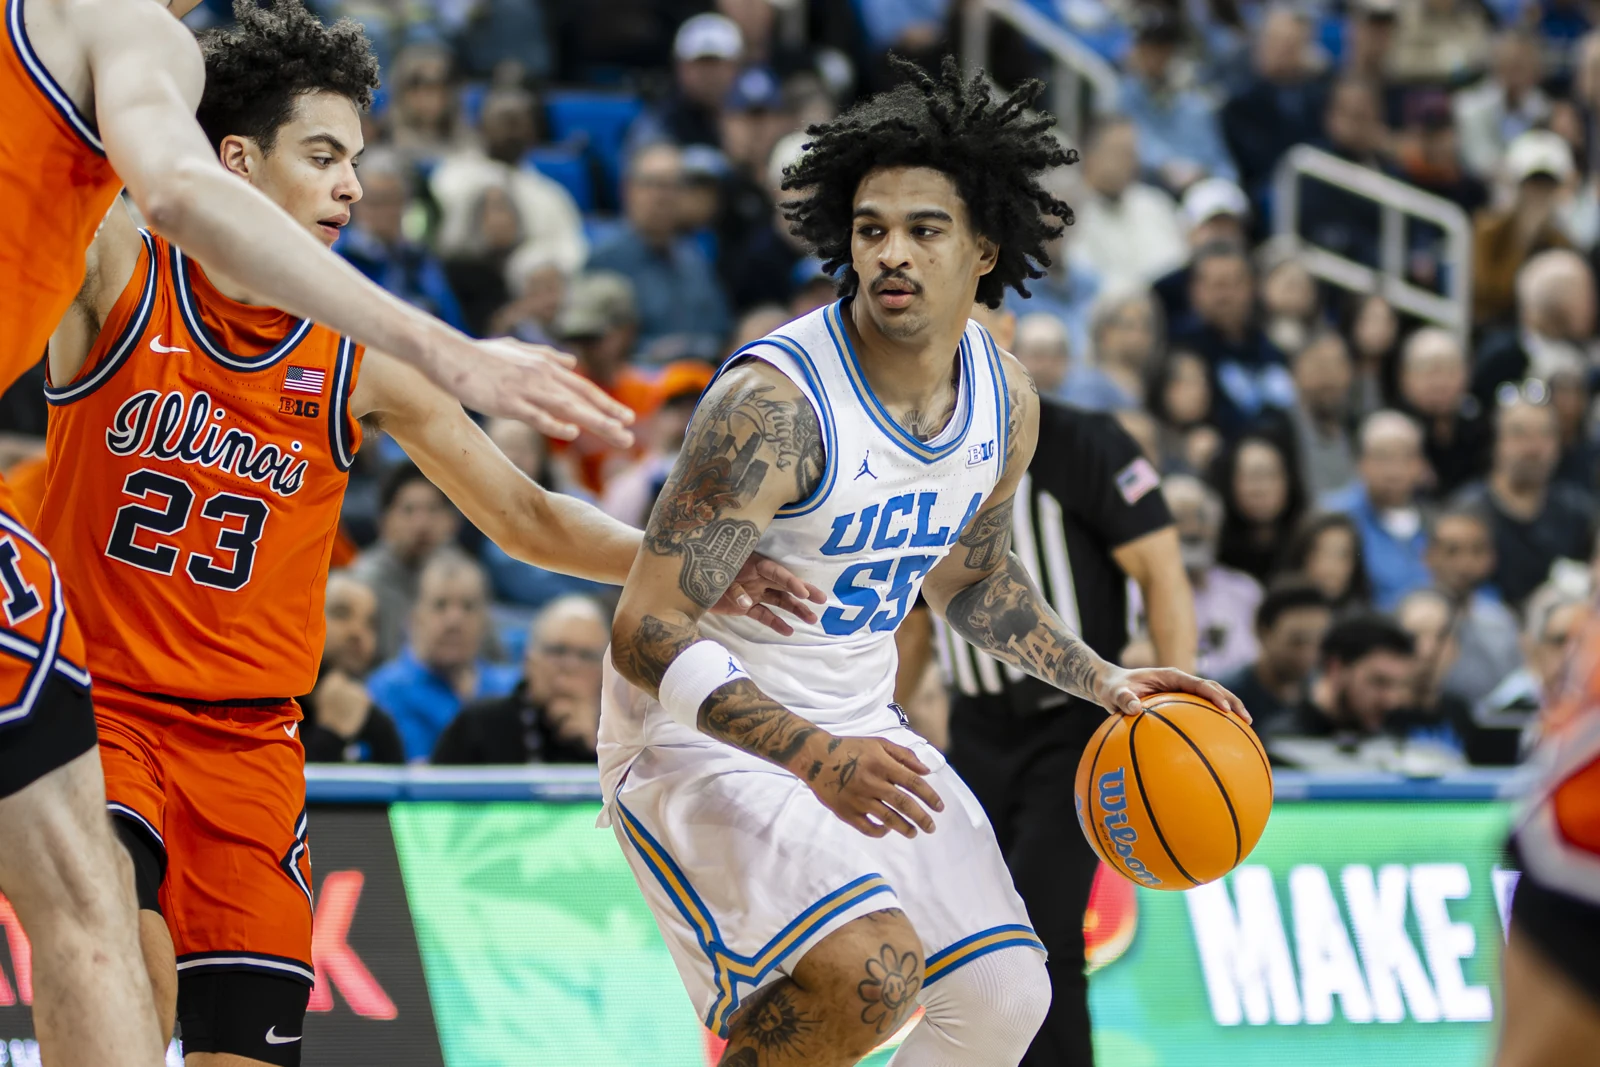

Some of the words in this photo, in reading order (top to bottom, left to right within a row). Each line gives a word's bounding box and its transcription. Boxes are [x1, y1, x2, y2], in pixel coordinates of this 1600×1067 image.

[105, 390, 308, 496] Illinois
[105, 468, 270, 591] 23
[821, 555, 940, 636] 55
[1098, 766, 1162, 885] Wilson
[1183, 863, 1494, 1026] MAKE
